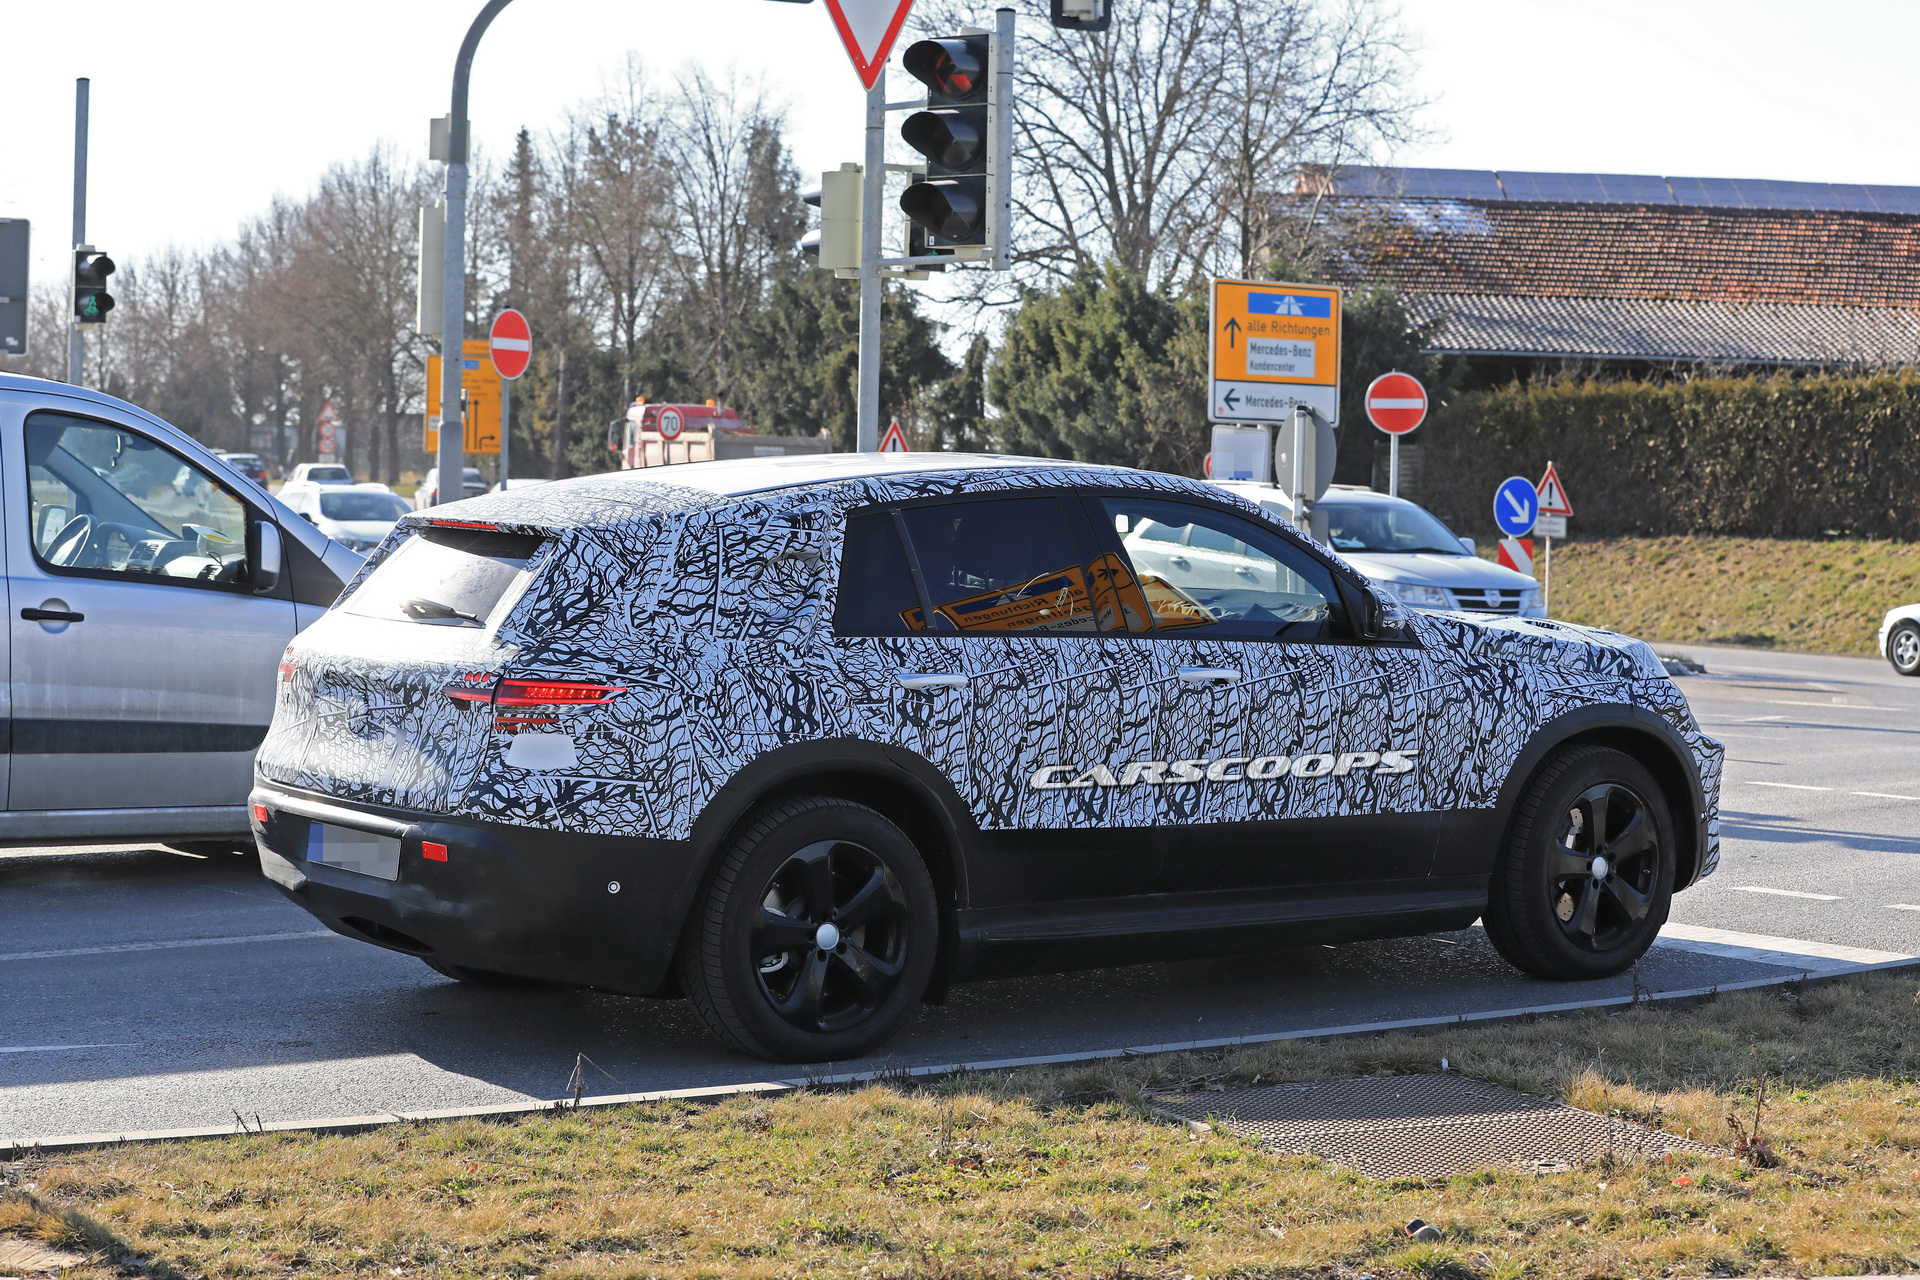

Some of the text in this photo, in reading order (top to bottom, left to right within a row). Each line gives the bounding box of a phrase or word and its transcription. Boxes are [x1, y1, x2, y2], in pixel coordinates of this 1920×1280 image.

[1247, 321, 1331, 338] alle Richtungen
[1249, 342, 1311, 358] Mercedes-Benz
[1249, 360, 1296, 373] Kundencenter
[664, 416, 678, 431] 70
